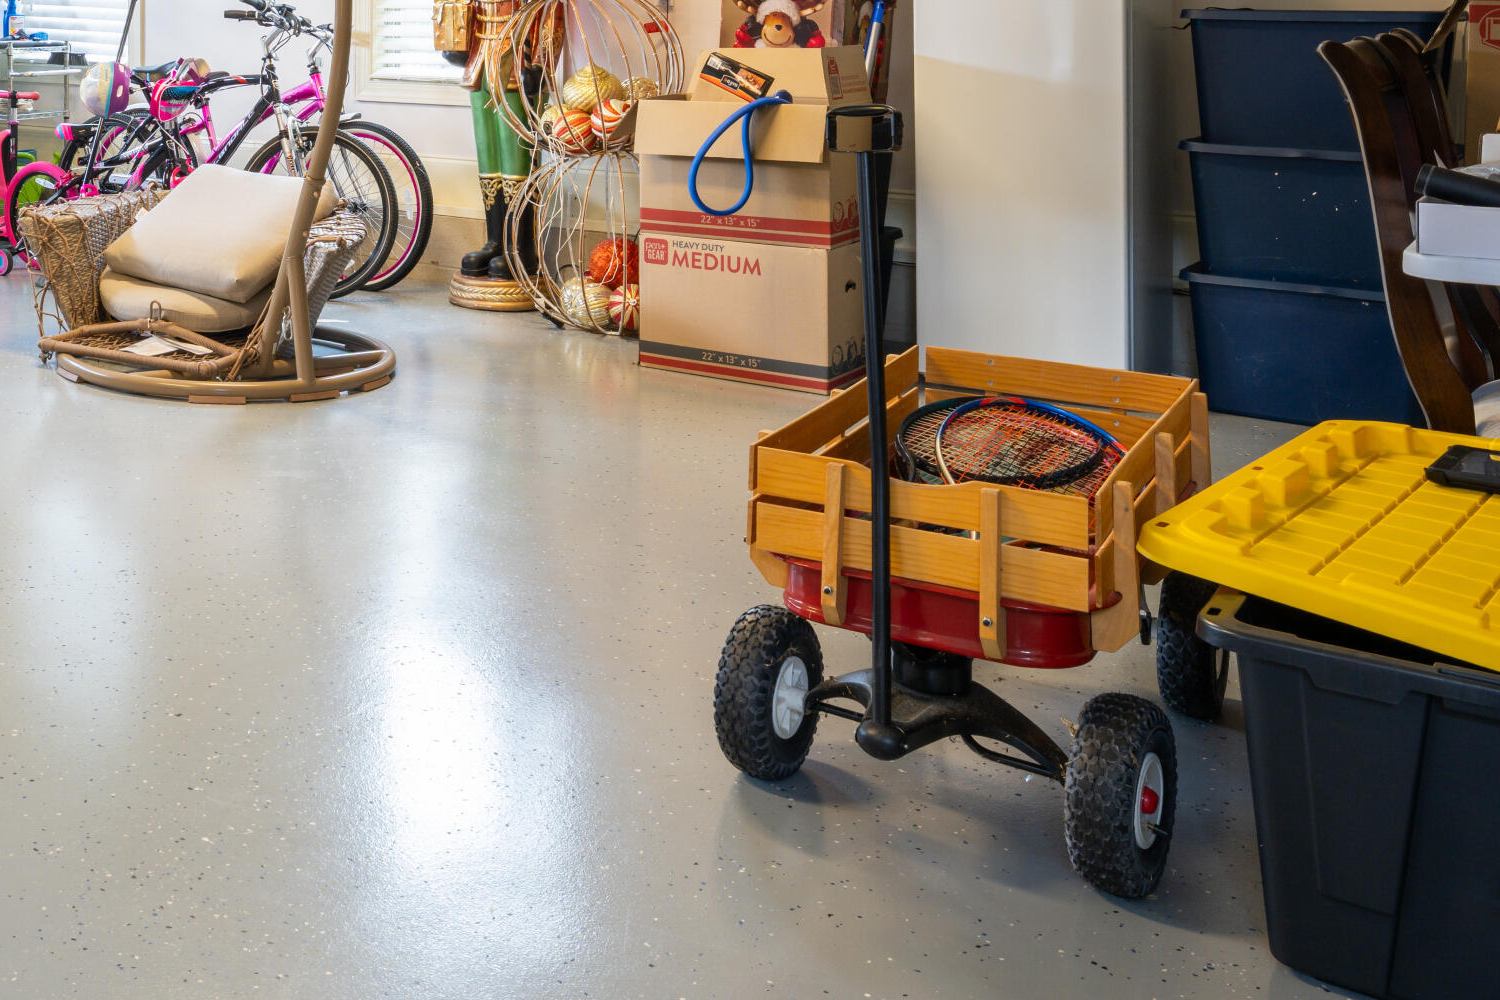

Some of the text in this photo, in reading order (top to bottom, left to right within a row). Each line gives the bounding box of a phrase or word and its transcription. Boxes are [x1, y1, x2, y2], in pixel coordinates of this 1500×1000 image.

[672, 240, 725, 252] HEAVY DUTY
[648, 249, 665, 261] GEAR
[672, 250, 761, 276] MEDIUM
